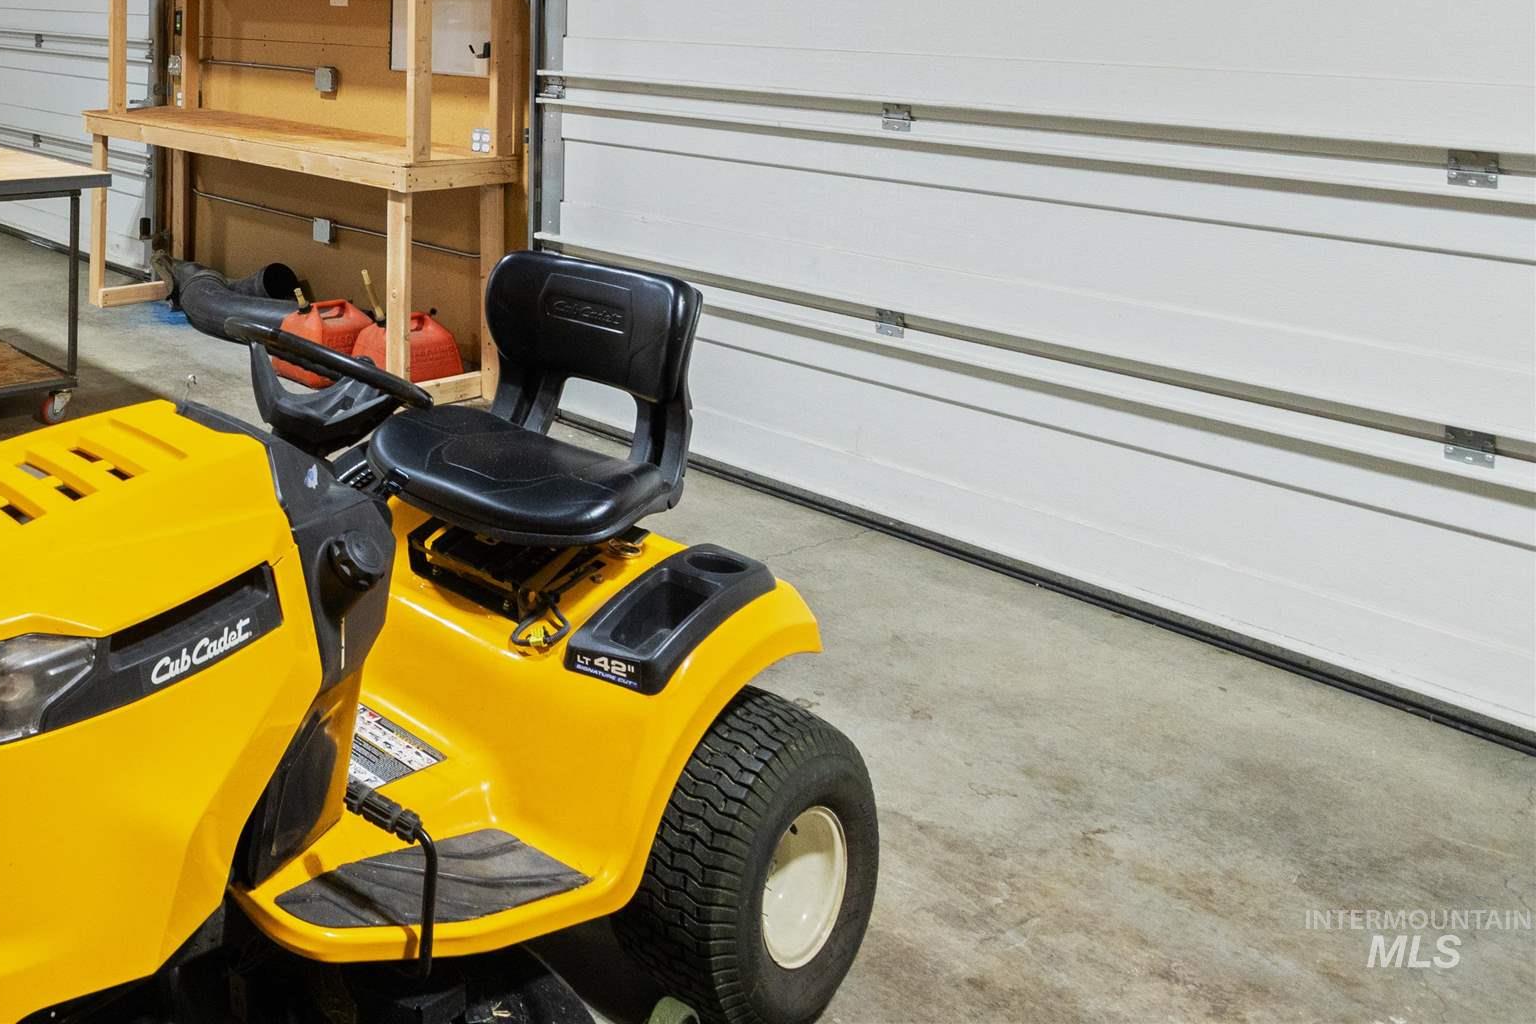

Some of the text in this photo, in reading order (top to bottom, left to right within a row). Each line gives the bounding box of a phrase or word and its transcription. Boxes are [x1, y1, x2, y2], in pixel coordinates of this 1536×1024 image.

[151, 617, 251, 684] Cub Cadet
[576, 654, 591, 665] LT
[576, 664, 616, 680] SIGNATURE
